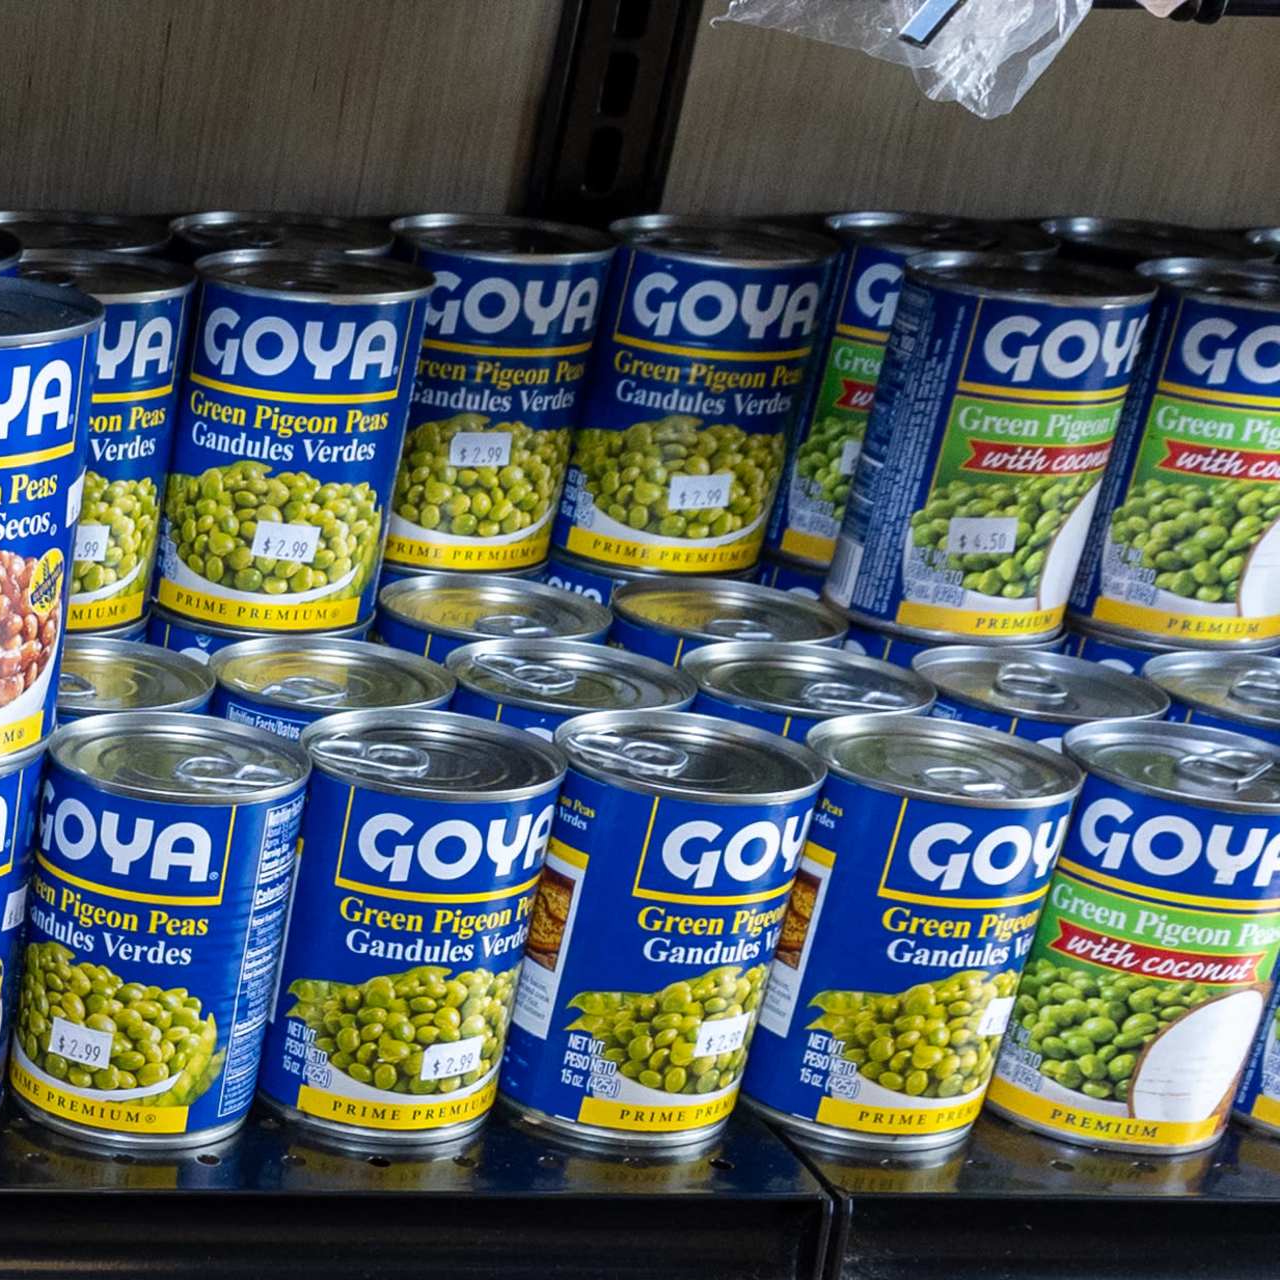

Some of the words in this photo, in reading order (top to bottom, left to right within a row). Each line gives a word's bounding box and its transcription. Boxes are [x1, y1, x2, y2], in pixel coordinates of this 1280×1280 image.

[633, 272, 819, 340] GOYA
[203, 307, 399, 380] GOYA
[190, 390, 246, 426] Green
[254, 404, 338, 438] Pigeon
[345, 409, 389, 434] Peas
[959, 406, 1038, 436] Green
[1156, 408, 1235, 440] Green
[192, 423, 293, 462] Gandules
[302, 438, 377, 463] Verdes
[981, 446, 1047, 472] with
[1175, 451, 1243, 477] with
[10, 472, 57, 503] Peas
[59, 892, 141, 937] Pigeon
[148, 909, 210, 936] Peas
[339, 896, 423, 934] Green
[434, 905, 512, 941] Pigeon
[638, 905, 724, 935] Green
[882, 906, 972, 939] Green
[1051, 883, 1127, 931] Green
[1133, 910, 1229, 949] Pigeon
[102, 929, 193, 966] Verdes
[346, 927, 475, 962] Gandules
[643, 938, 761, 965] Gandules
[886, 938, 1010, 968] Gandules
[1066, 932, 1140, 969] with
[1140, 953, 1254, 982] coconut
[56, 1036, 102, 1063] $2.99
[569, 1032, 586, 1051] NET
[561, 1068, 571, 1084] 15
[564, 1048, 588, 1069] PESO
[590, 1056, 616, 1074] NETO
[1049, 1108, 1159, 1138] PREMIUM
